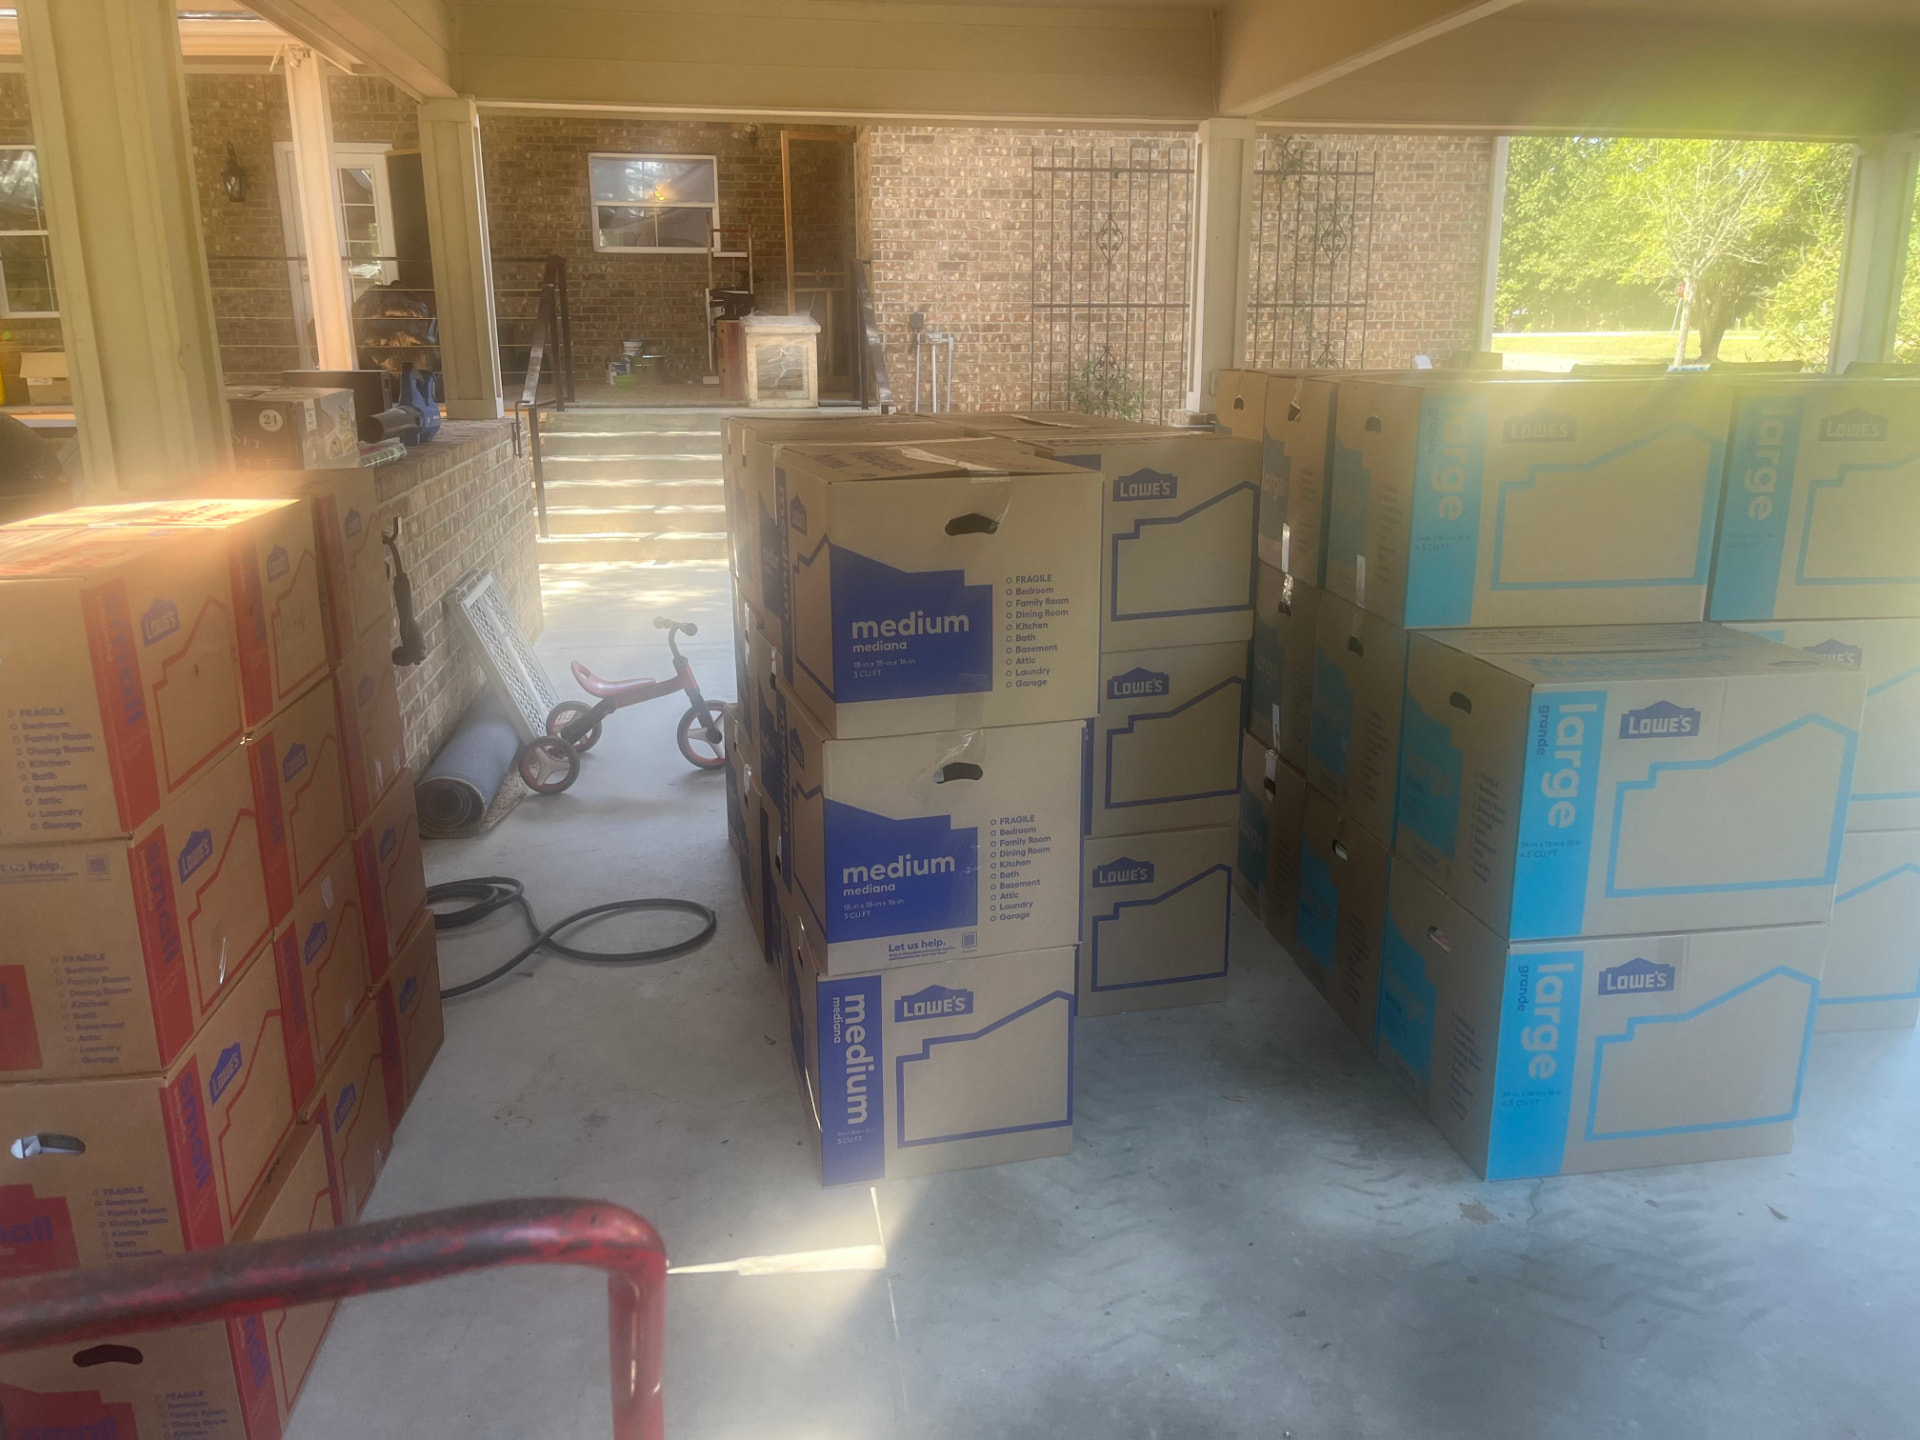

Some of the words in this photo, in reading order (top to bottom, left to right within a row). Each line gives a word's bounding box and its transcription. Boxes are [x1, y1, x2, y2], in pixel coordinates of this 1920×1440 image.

[1511, 421, 1569, 439] LOWE'S
[1826, 421, 1881, 438] LOWE'S
[1744, 406, 1795, 521] large
[1119, 480, 1172, 498] LOWE'S
[1015, 574, 1053, 584] FRAGILE
[1015, 587, 1054, 596] Bedroom
[1015, 599, 1044, 608] Family
[1045, 597, 1070, 606] Room
[1015, 610, 1043, 620] Dining
[1044, 609, 1069, 617] Room
[851, 610, 970, 639] medium
[1015, 622, 1048, 631] Kitchen
[1015, 633, 1036, 642] Bath
[852, 640, 908, 653] mediana
[1015, 644, 1058, 654] Basement
[1015, 656, 1036, 665] Attic
[1015, 667, 1051, 677] Laundry
[1015, 679, 1048, 688] Garage
[1114, 678, 1163, 695] LOWE'S
[1537, 704, 1550, 756] grande
[1628, 714, 1692, 735] LOWE'S
[1541, 703, 1598, 829] large
[999, 814, 1035, 825] FRAGILE
[1000, 827, 1037, 836] Bedroom
[1000, 838, 1027, 847] Family
[1000, 848, 1026, 858] Dining
[843, 854, 956, 884] medium
[1000, 859, 1032, 869] Kitchen
[1000, 870, 1020, 879] Bath
[1099, 867, 1149, 884] LOWE'S
[843, 883, 896, 896] mediana
[1000, 879, 1041, 890] Basement
[1000, 891, 1020, 900] Attic
[1000, 900, 1034, 911] Laundry
[1000, 911, 1031, 921] Garage
[888, 943, 905, 952] Let
[907, 942, 919, 950] us
[921, 939, 946, 949] help.
[1606, 971, 1667, 991] LOWE'S
[1517, 964, 1530, 1012] grande
[903, 995, 966, 1018] LOWE'S
[832, 997, 843, 1044] mediana
[1521, 963, 1575, 1080] large
[844, 994, 875, 1125] medium
[180, 1072, 213, 1191] small
[0, 1216, 55, 1243] all
